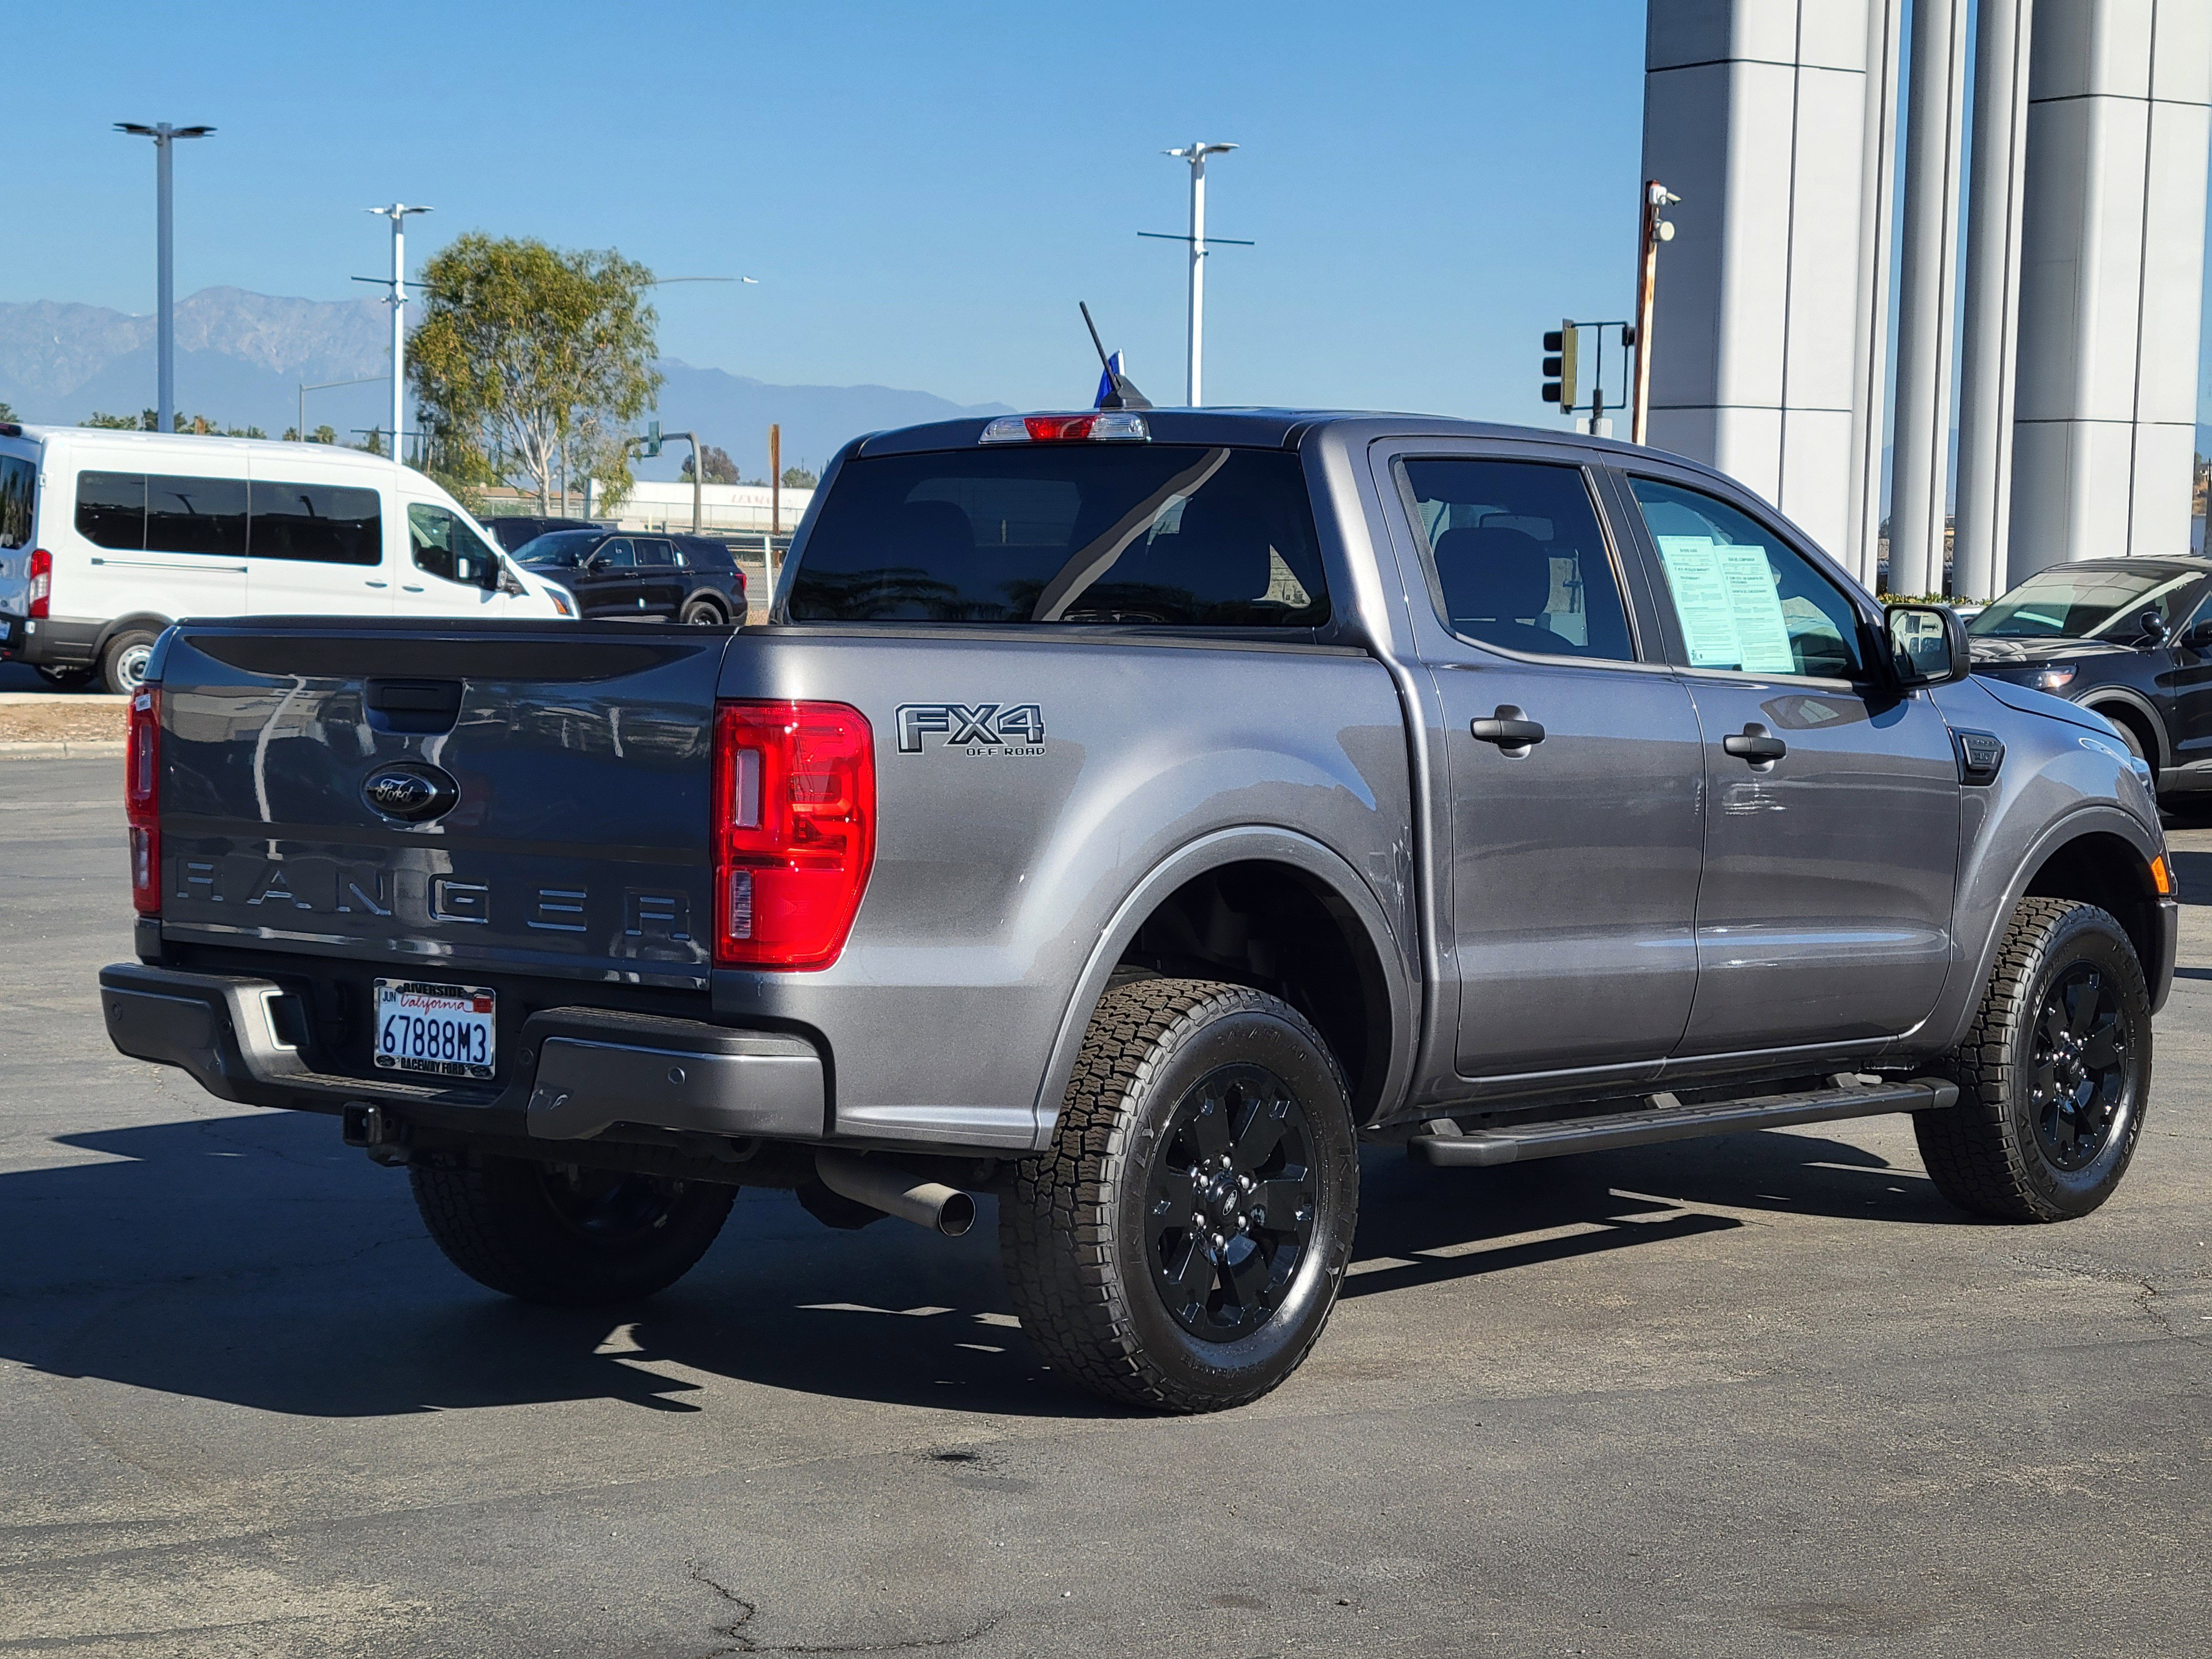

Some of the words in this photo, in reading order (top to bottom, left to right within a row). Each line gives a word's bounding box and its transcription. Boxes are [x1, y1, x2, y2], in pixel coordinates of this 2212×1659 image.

[894, 702, 1046, 755] FX4
[966, 747, 998, 757] OFF
[1004, 747, 1046, 757] ROAD
[375, 778, 414, 803] Ford
[174, 856, 692, 940] RANGER
[382, 991, 396, 1002] JUN
[403, 982, 466, 997] RIVERSIDE
[400, 994, 473, 1015] California
[383, 1014, 486, 1063] 67888M3
[401, 1057, 441, 1073] RACEWAY
[442, 1063, 466, 1075] FORD
